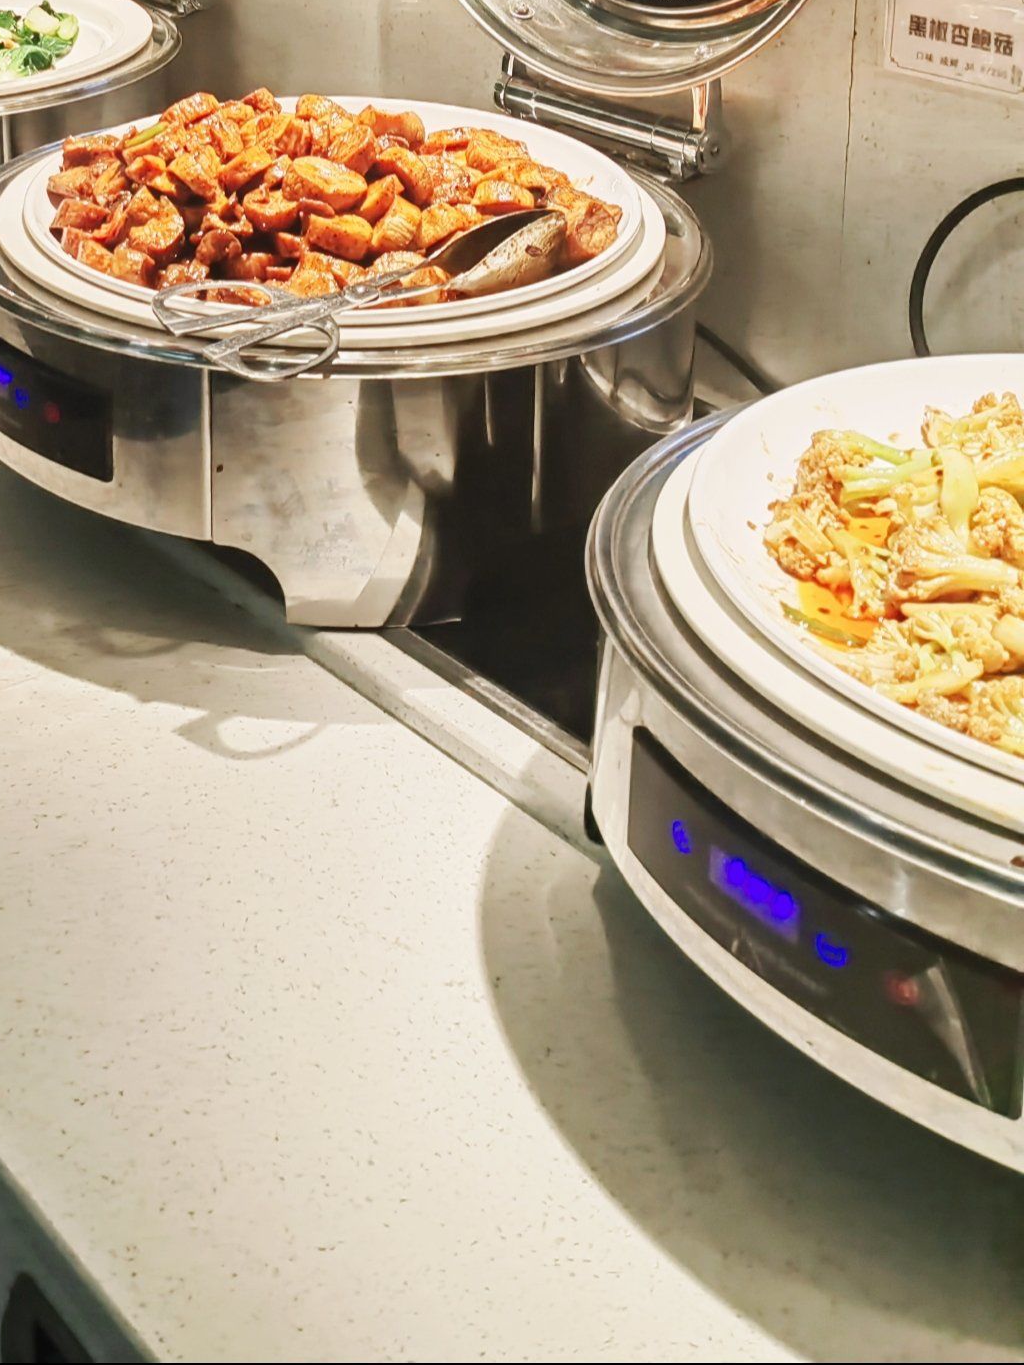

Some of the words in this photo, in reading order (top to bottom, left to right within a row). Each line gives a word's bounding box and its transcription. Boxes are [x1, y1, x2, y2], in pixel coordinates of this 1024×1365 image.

[908, 13, 1015, 58] 黑椒杏鲍菇
